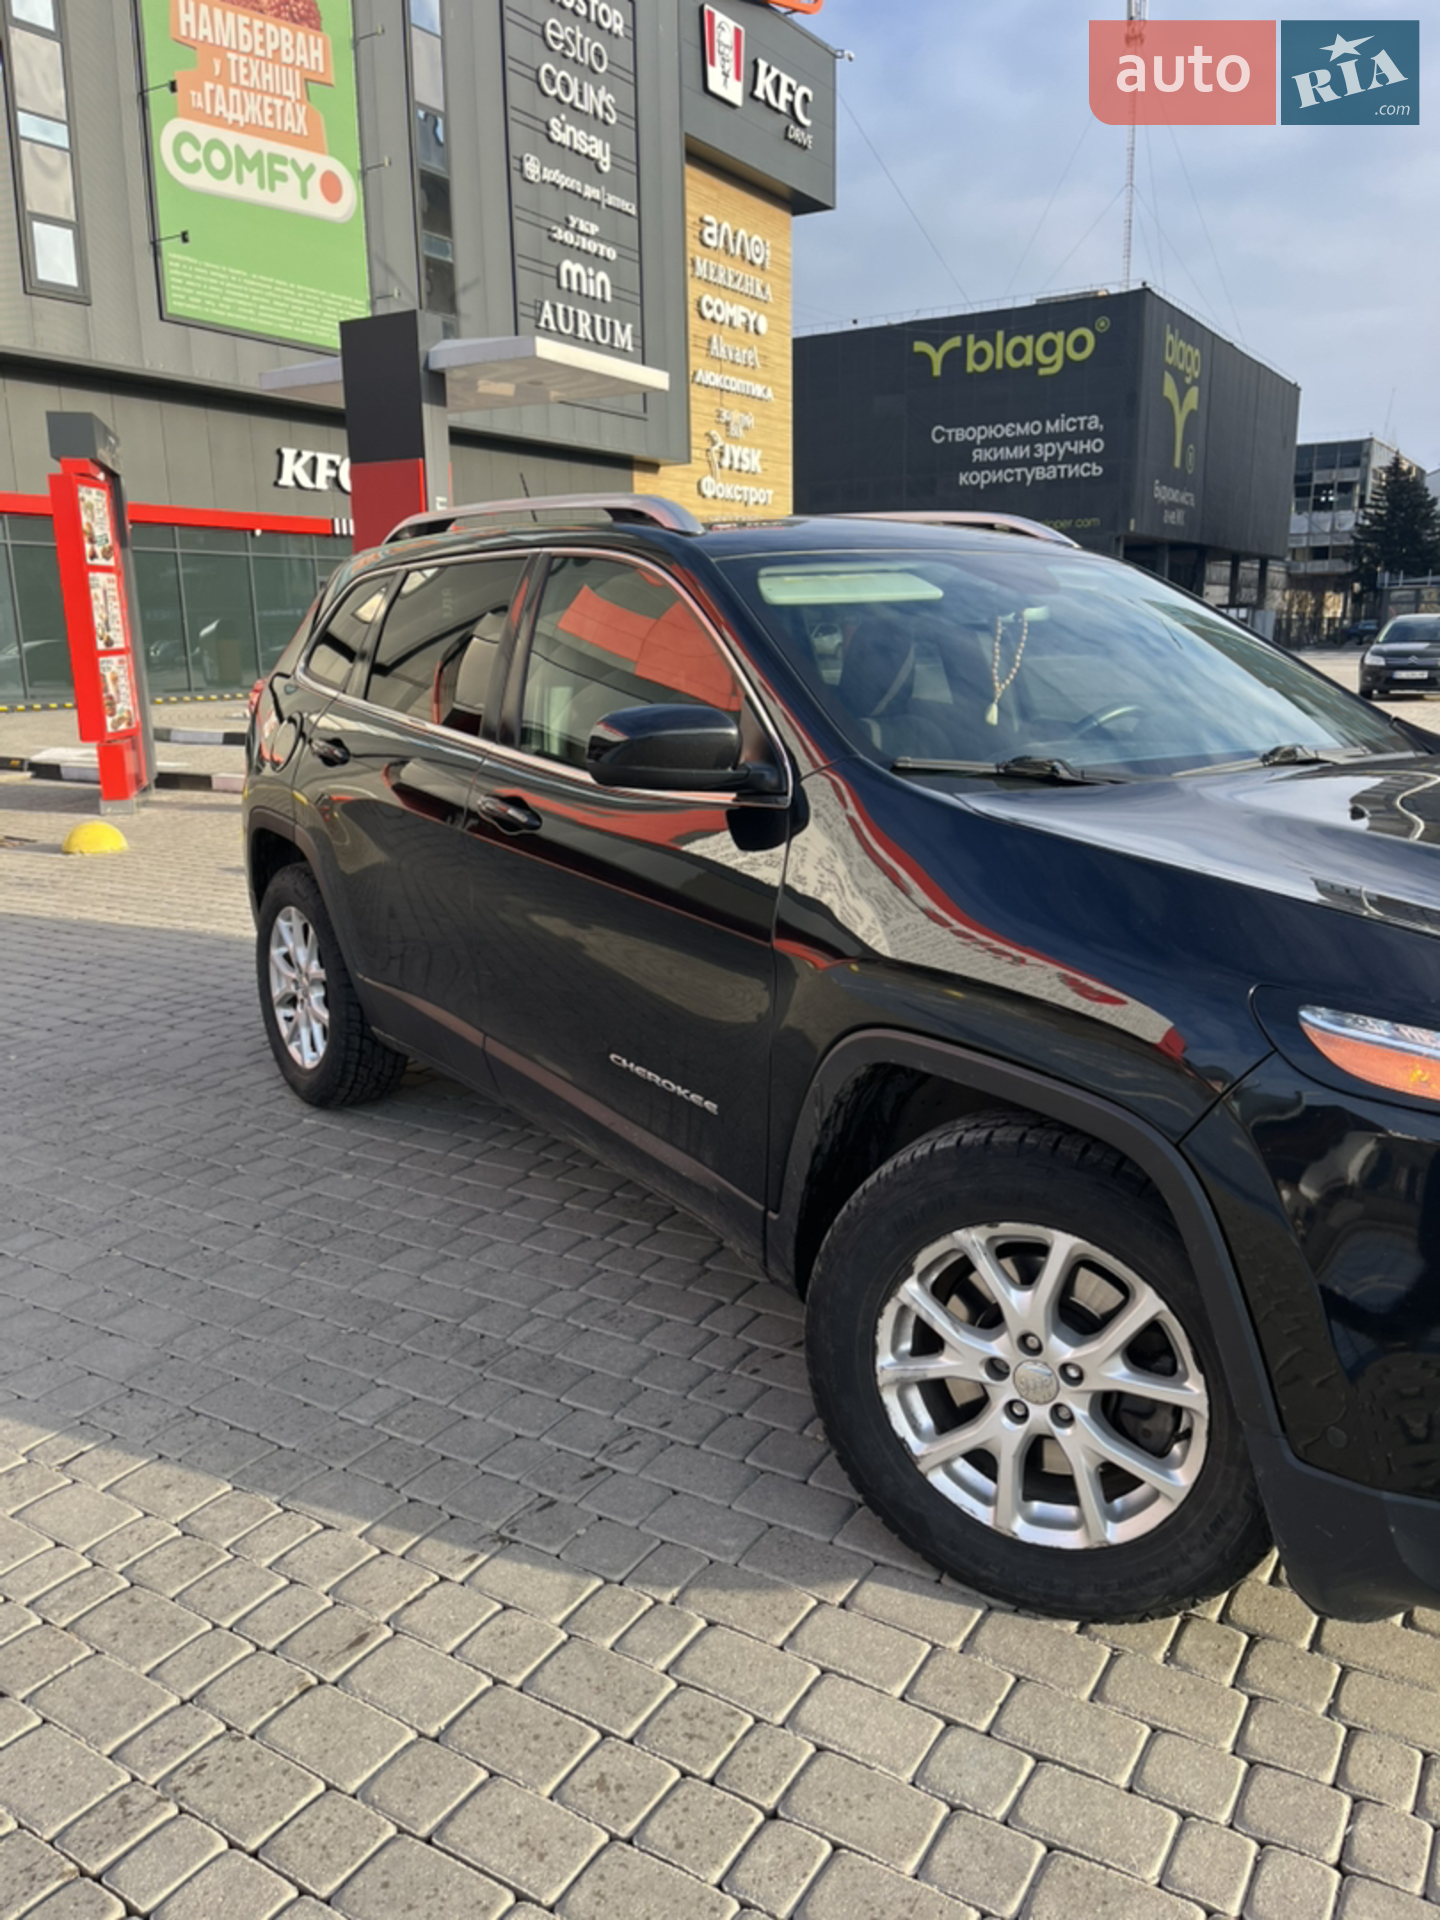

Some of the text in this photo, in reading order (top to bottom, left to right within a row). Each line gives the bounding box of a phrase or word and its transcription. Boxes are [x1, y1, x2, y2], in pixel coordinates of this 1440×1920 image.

[178, 0, 325, 73] НАМБЕРВАН
[545, 18, 608, 73] estro
[227, 52, 302, 102] ТЕХНІЦІ
[753, 57, 813, 127] KFC
[203, 81, 308, 136] ГАДЖЕТАХ
[550, 114, 611, 172] sinsay
[788, 124, 813, 150] DRIVE
[172, 130, 316, 200] COMFY
[551, 225, 617, 261] ЗОЛОТО
[568, 215, 599, 236] УКР
[560, 259, 612, 303] min
[694, 255, 773, 303] MEREZHKA
[538, 300, 634, 352] AURUM
[701, 294, 758, 334] COMFY
[966, 327, 1096, 376] blago
[1165, 324, 1201, 384] blago
[931, 414, 1104, 445] Створюємо міста,
[971, 437, 1105, 463] якими зручно
[722, 444, 762, 473] JYSK
[958, 461, 1103, 490] користуватись
[701, 475, 774, 506] Фокстрот
[609, 1053, 719, 1115] CHEROKEE
